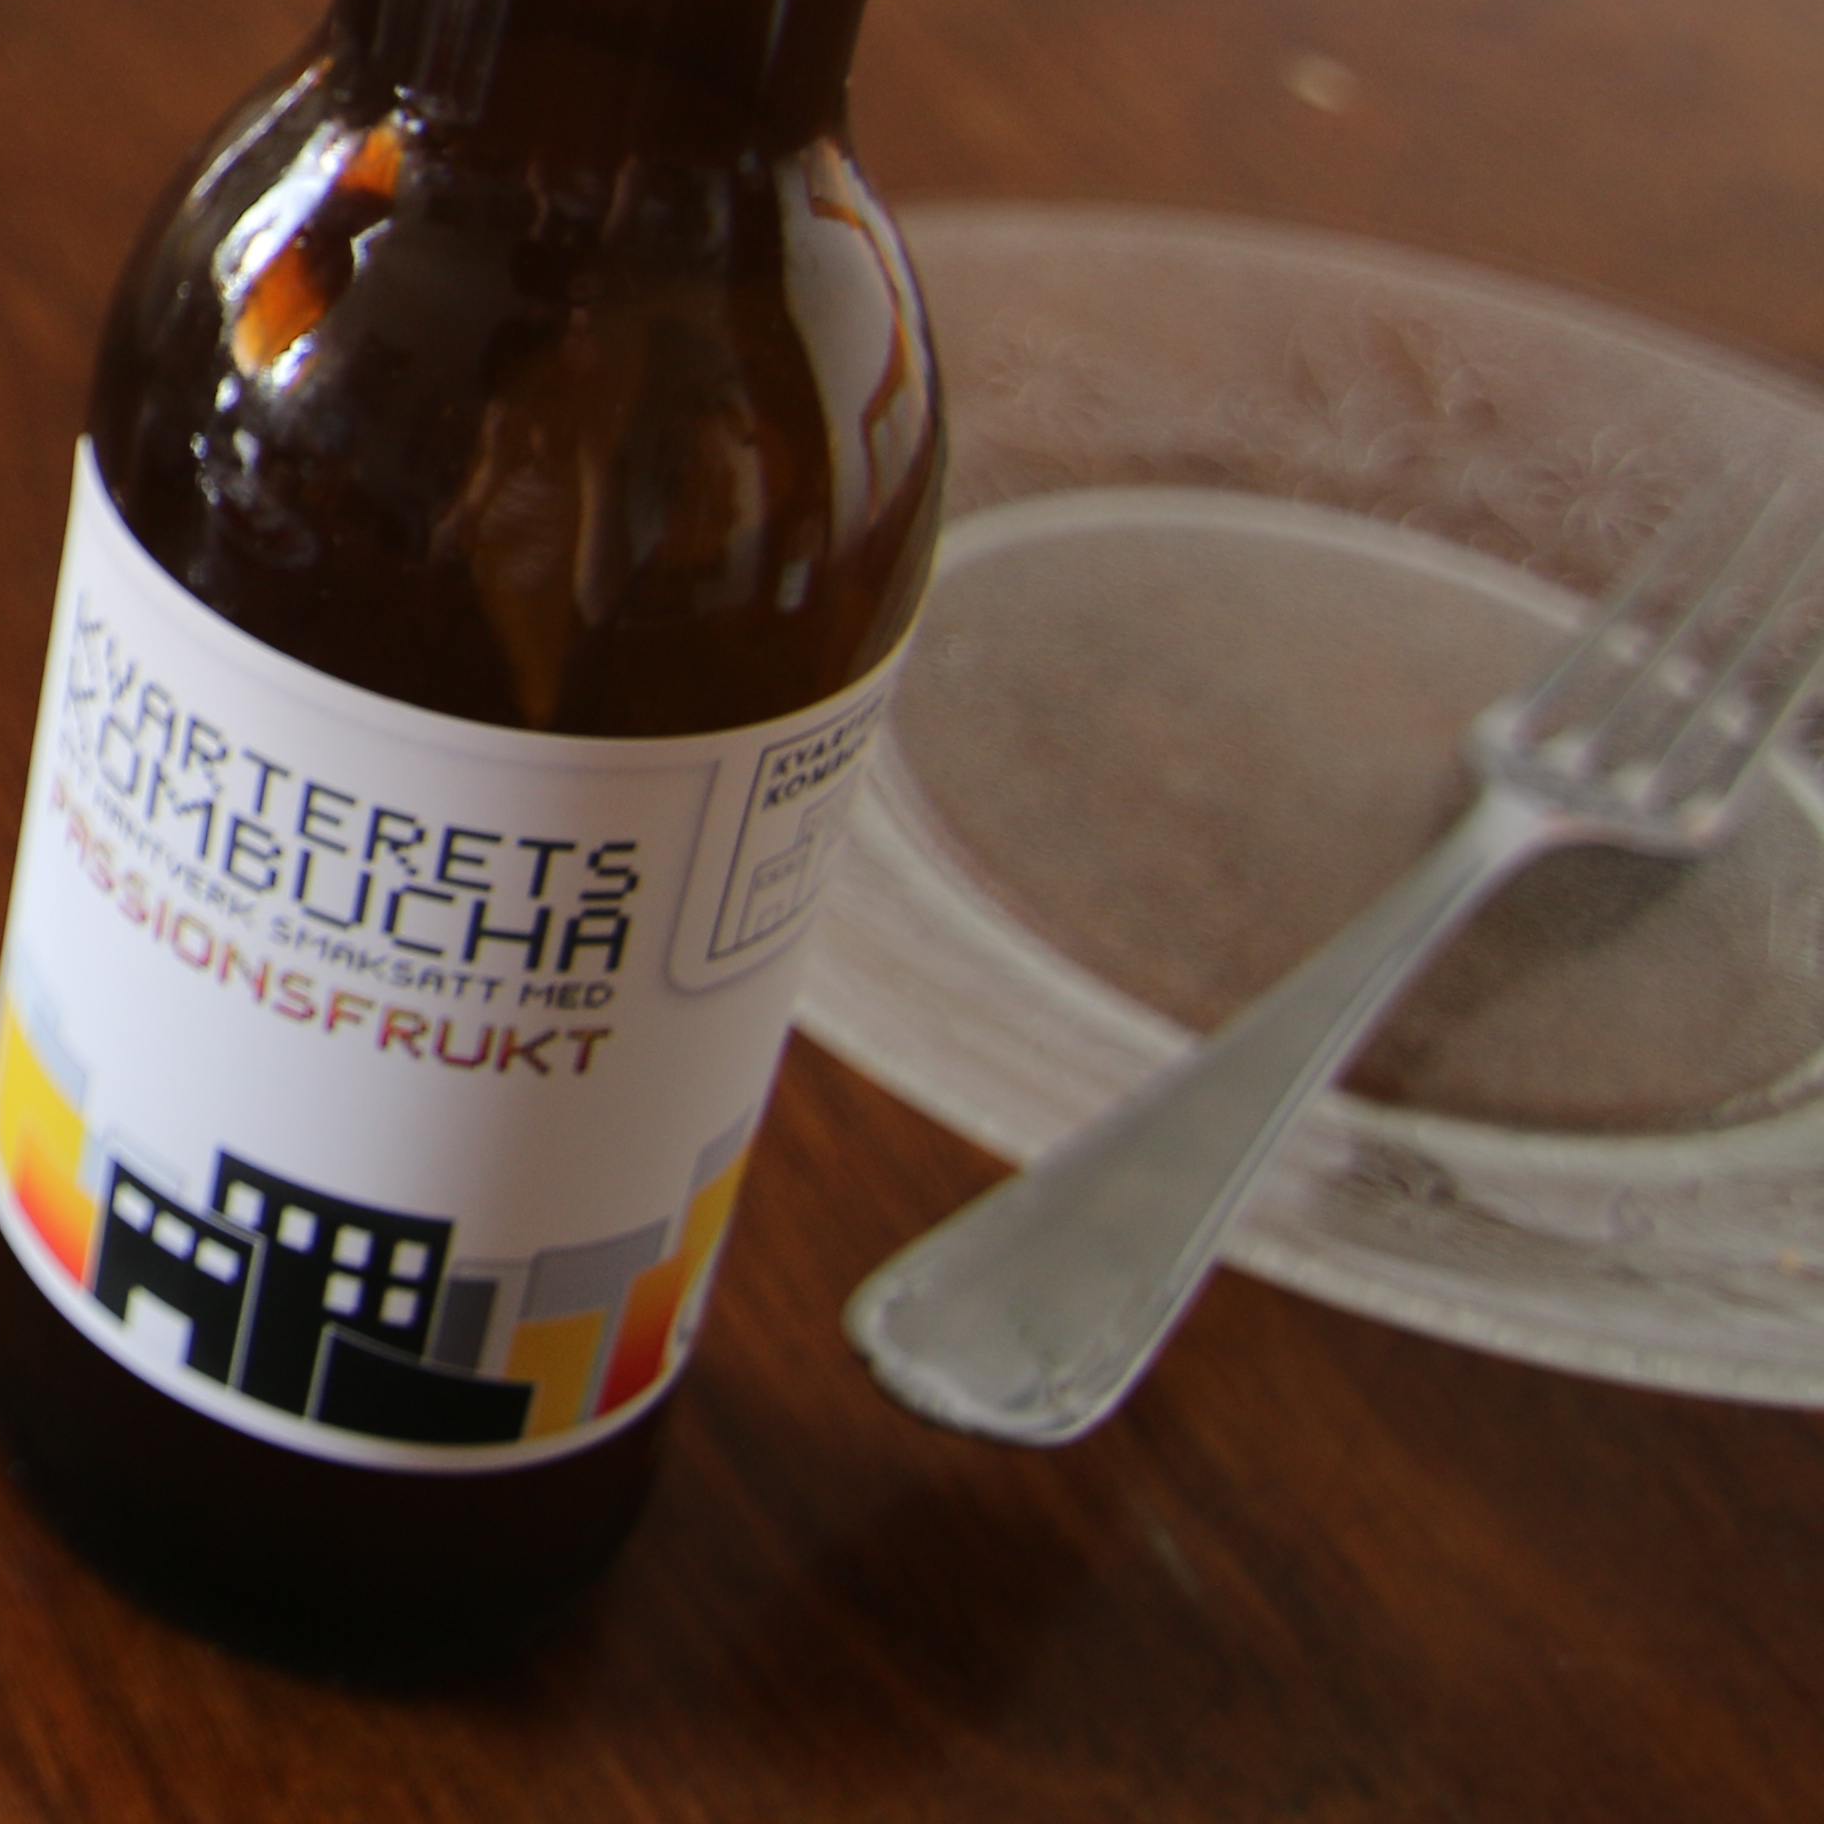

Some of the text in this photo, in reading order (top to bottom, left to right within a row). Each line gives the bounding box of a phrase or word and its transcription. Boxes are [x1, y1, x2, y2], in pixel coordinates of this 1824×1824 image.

[63, 656, 630, 972] KOMBUCHA
[70, 588, 640, 900] KVARTERETS
[48, 771, 613, 1076] PASSIONSFRUKT
[268, 913, 502, 1004] SMAKSATT
[518, 981, 615, 1010] MED
